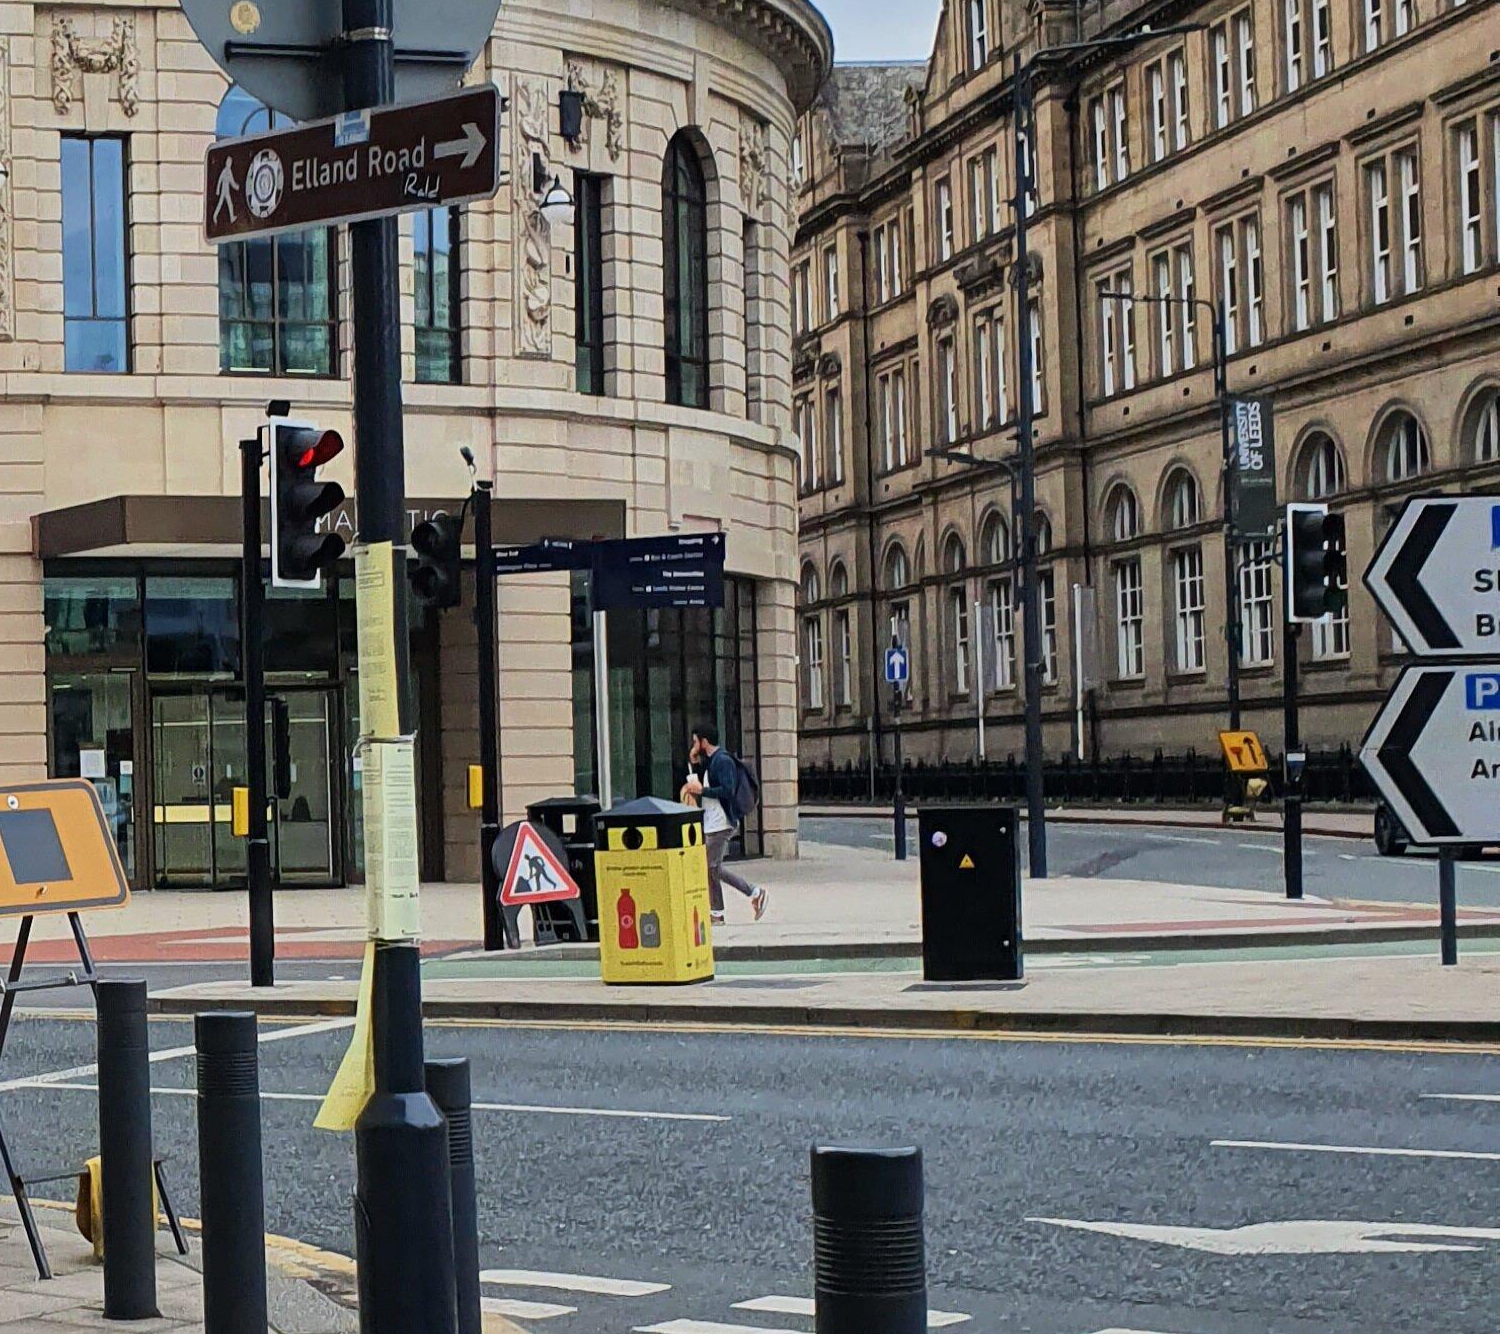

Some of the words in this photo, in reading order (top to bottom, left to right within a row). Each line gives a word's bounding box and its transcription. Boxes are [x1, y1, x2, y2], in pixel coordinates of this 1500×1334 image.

[292, 149, 358, 192] Elland
[368, 135, 426, 177] Road
[1235, 400, 1251, 470] UNIVERSITY
[1247, 401, 1263, 448] LEEDS
[1250, 449, 1264, 470] OF
[1473, 569, 1500, 593] S
[1476, 613, 1500, 637] B
